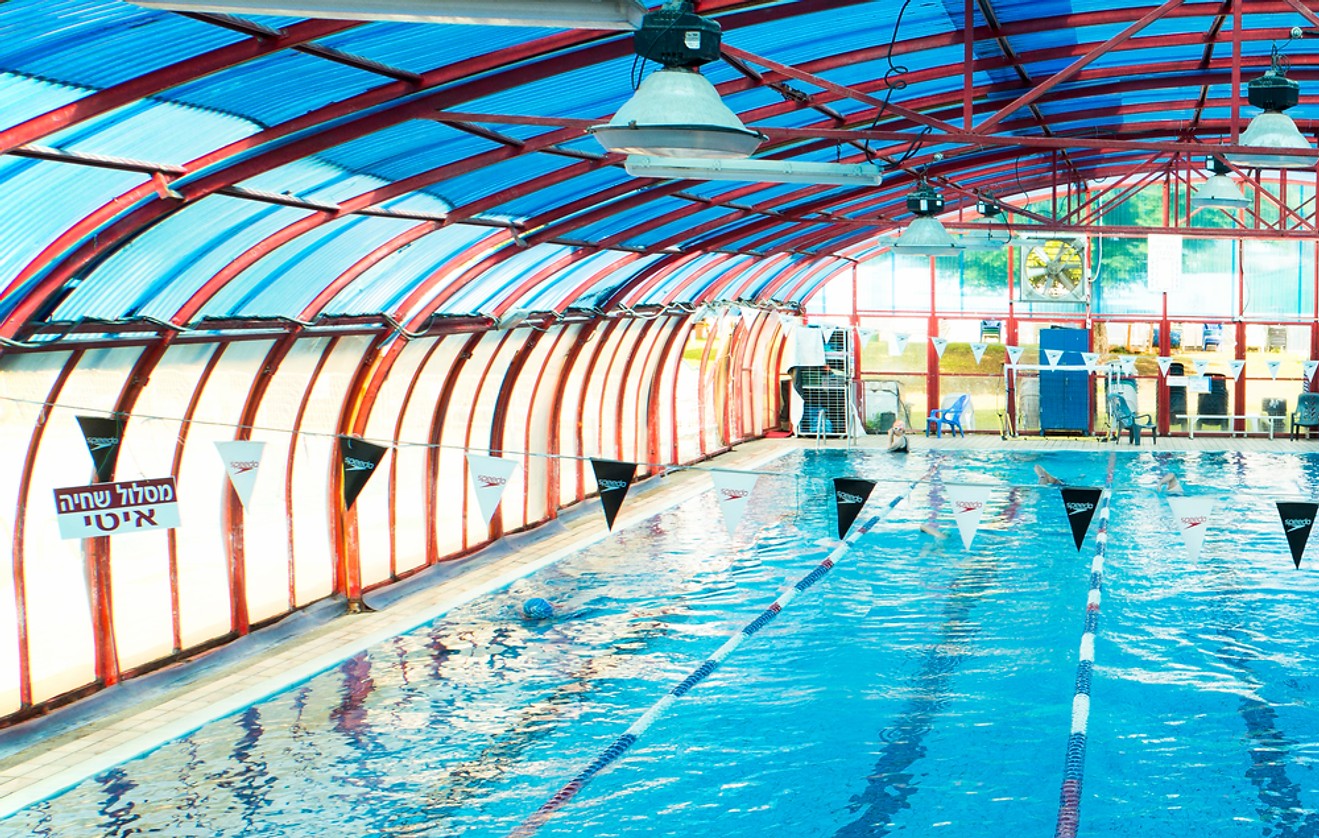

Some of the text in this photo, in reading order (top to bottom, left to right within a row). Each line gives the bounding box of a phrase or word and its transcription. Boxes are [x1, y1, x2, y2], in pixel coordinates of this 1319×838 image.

[87, 436, 118, 448] speedo
[230, 460, 260, 469] speedo
[344, 456, 374, 470] speedo
[477, 474, 506, 485] speedo
[598, 478, 627, 489] speedo
[59, 483, 173, 512] מסלול שחיה
[720, 488, 748, 498] speedo
[836, 491, 863, 502] speedo
[955, 501, 983, 510] speedo
[1066, 502, 1094, 512] speedo
[84, 508, 158, 532] איטי
[1181, 516, 1207, 525] speedo
[1284, 518, 1312, 529] speedo
